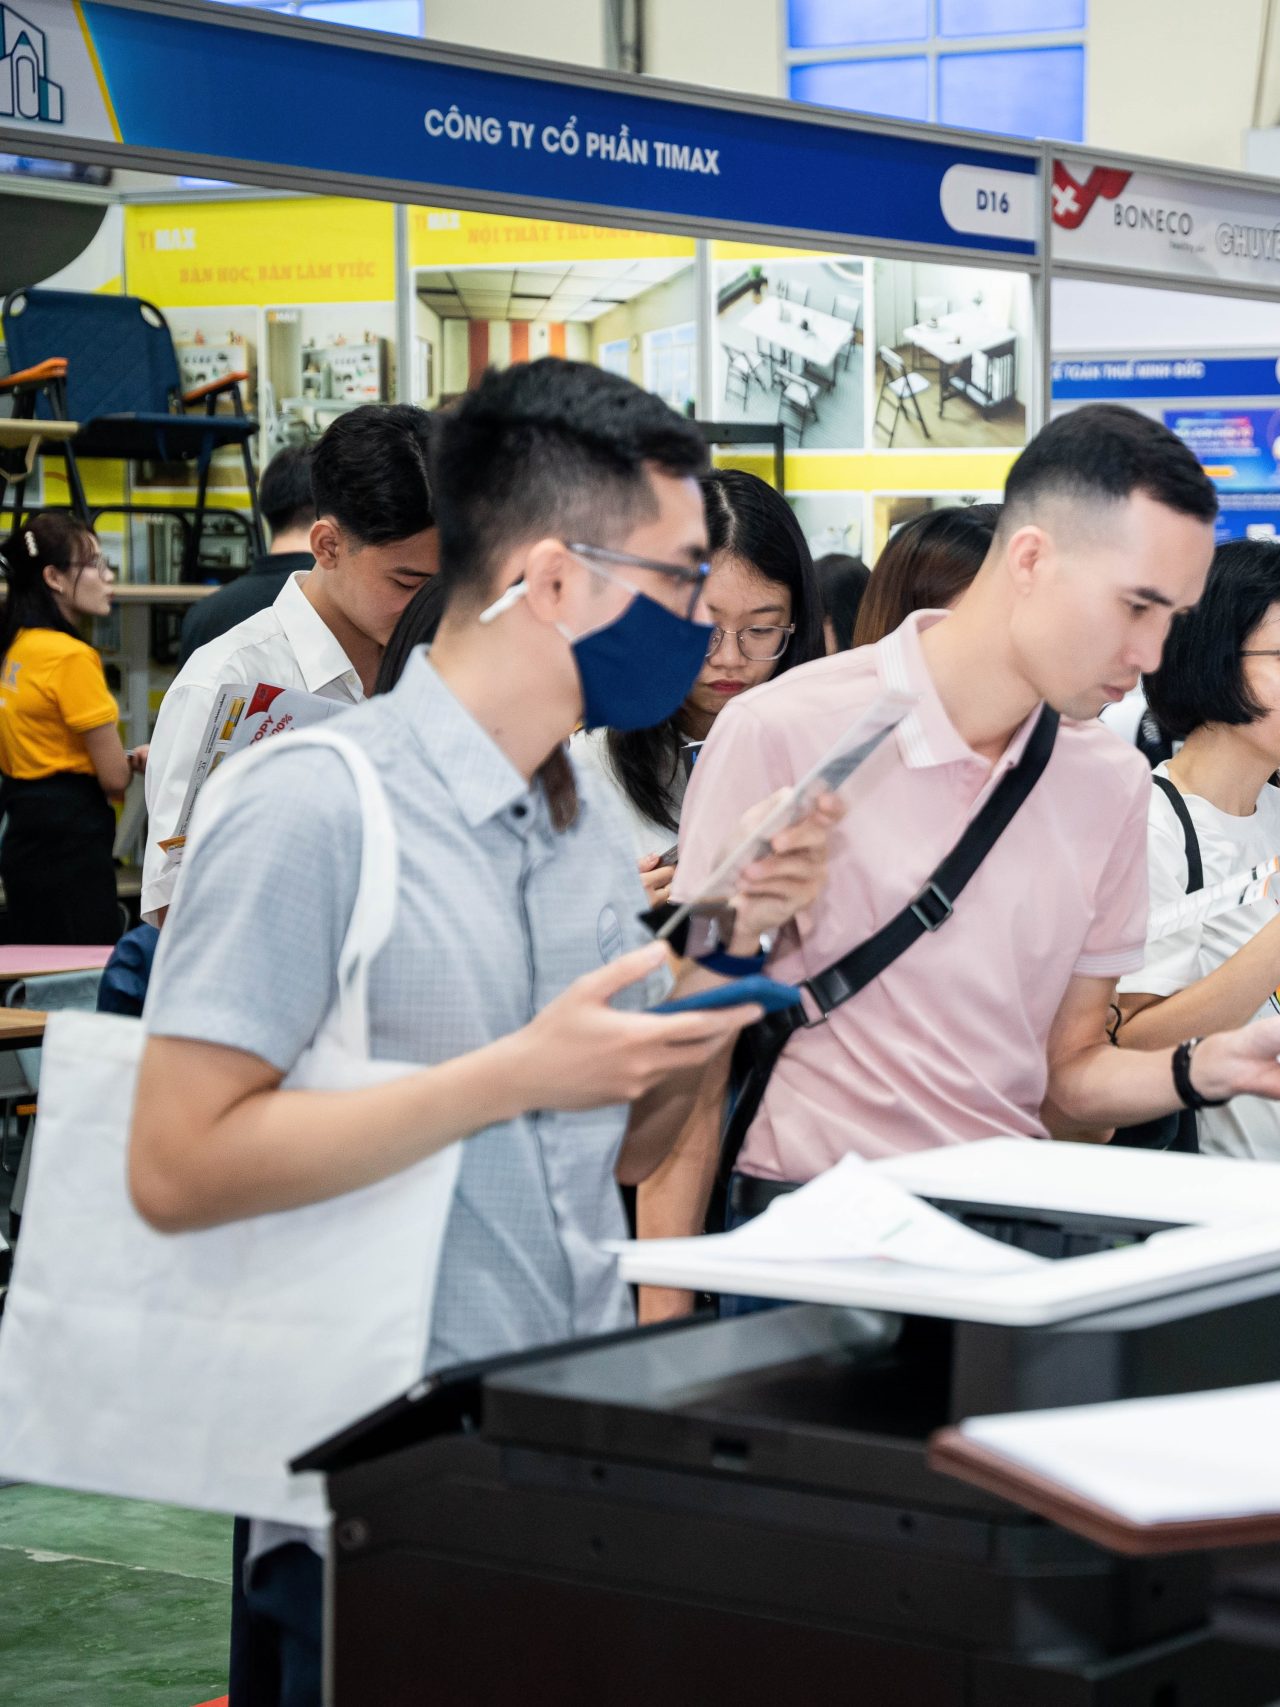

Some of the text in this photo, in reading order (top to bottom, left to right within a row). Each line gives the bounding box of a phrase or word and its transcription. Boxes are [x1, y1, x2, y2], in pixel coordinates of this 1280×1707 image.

[424, 104, 720, 176] CÔNG TY CỔ PHẦN TIMAX
[976, 188, 1010, 214] D16
[1113, 202, 1193, 236] BONECO
[268, 713, 293, 737] 00%
